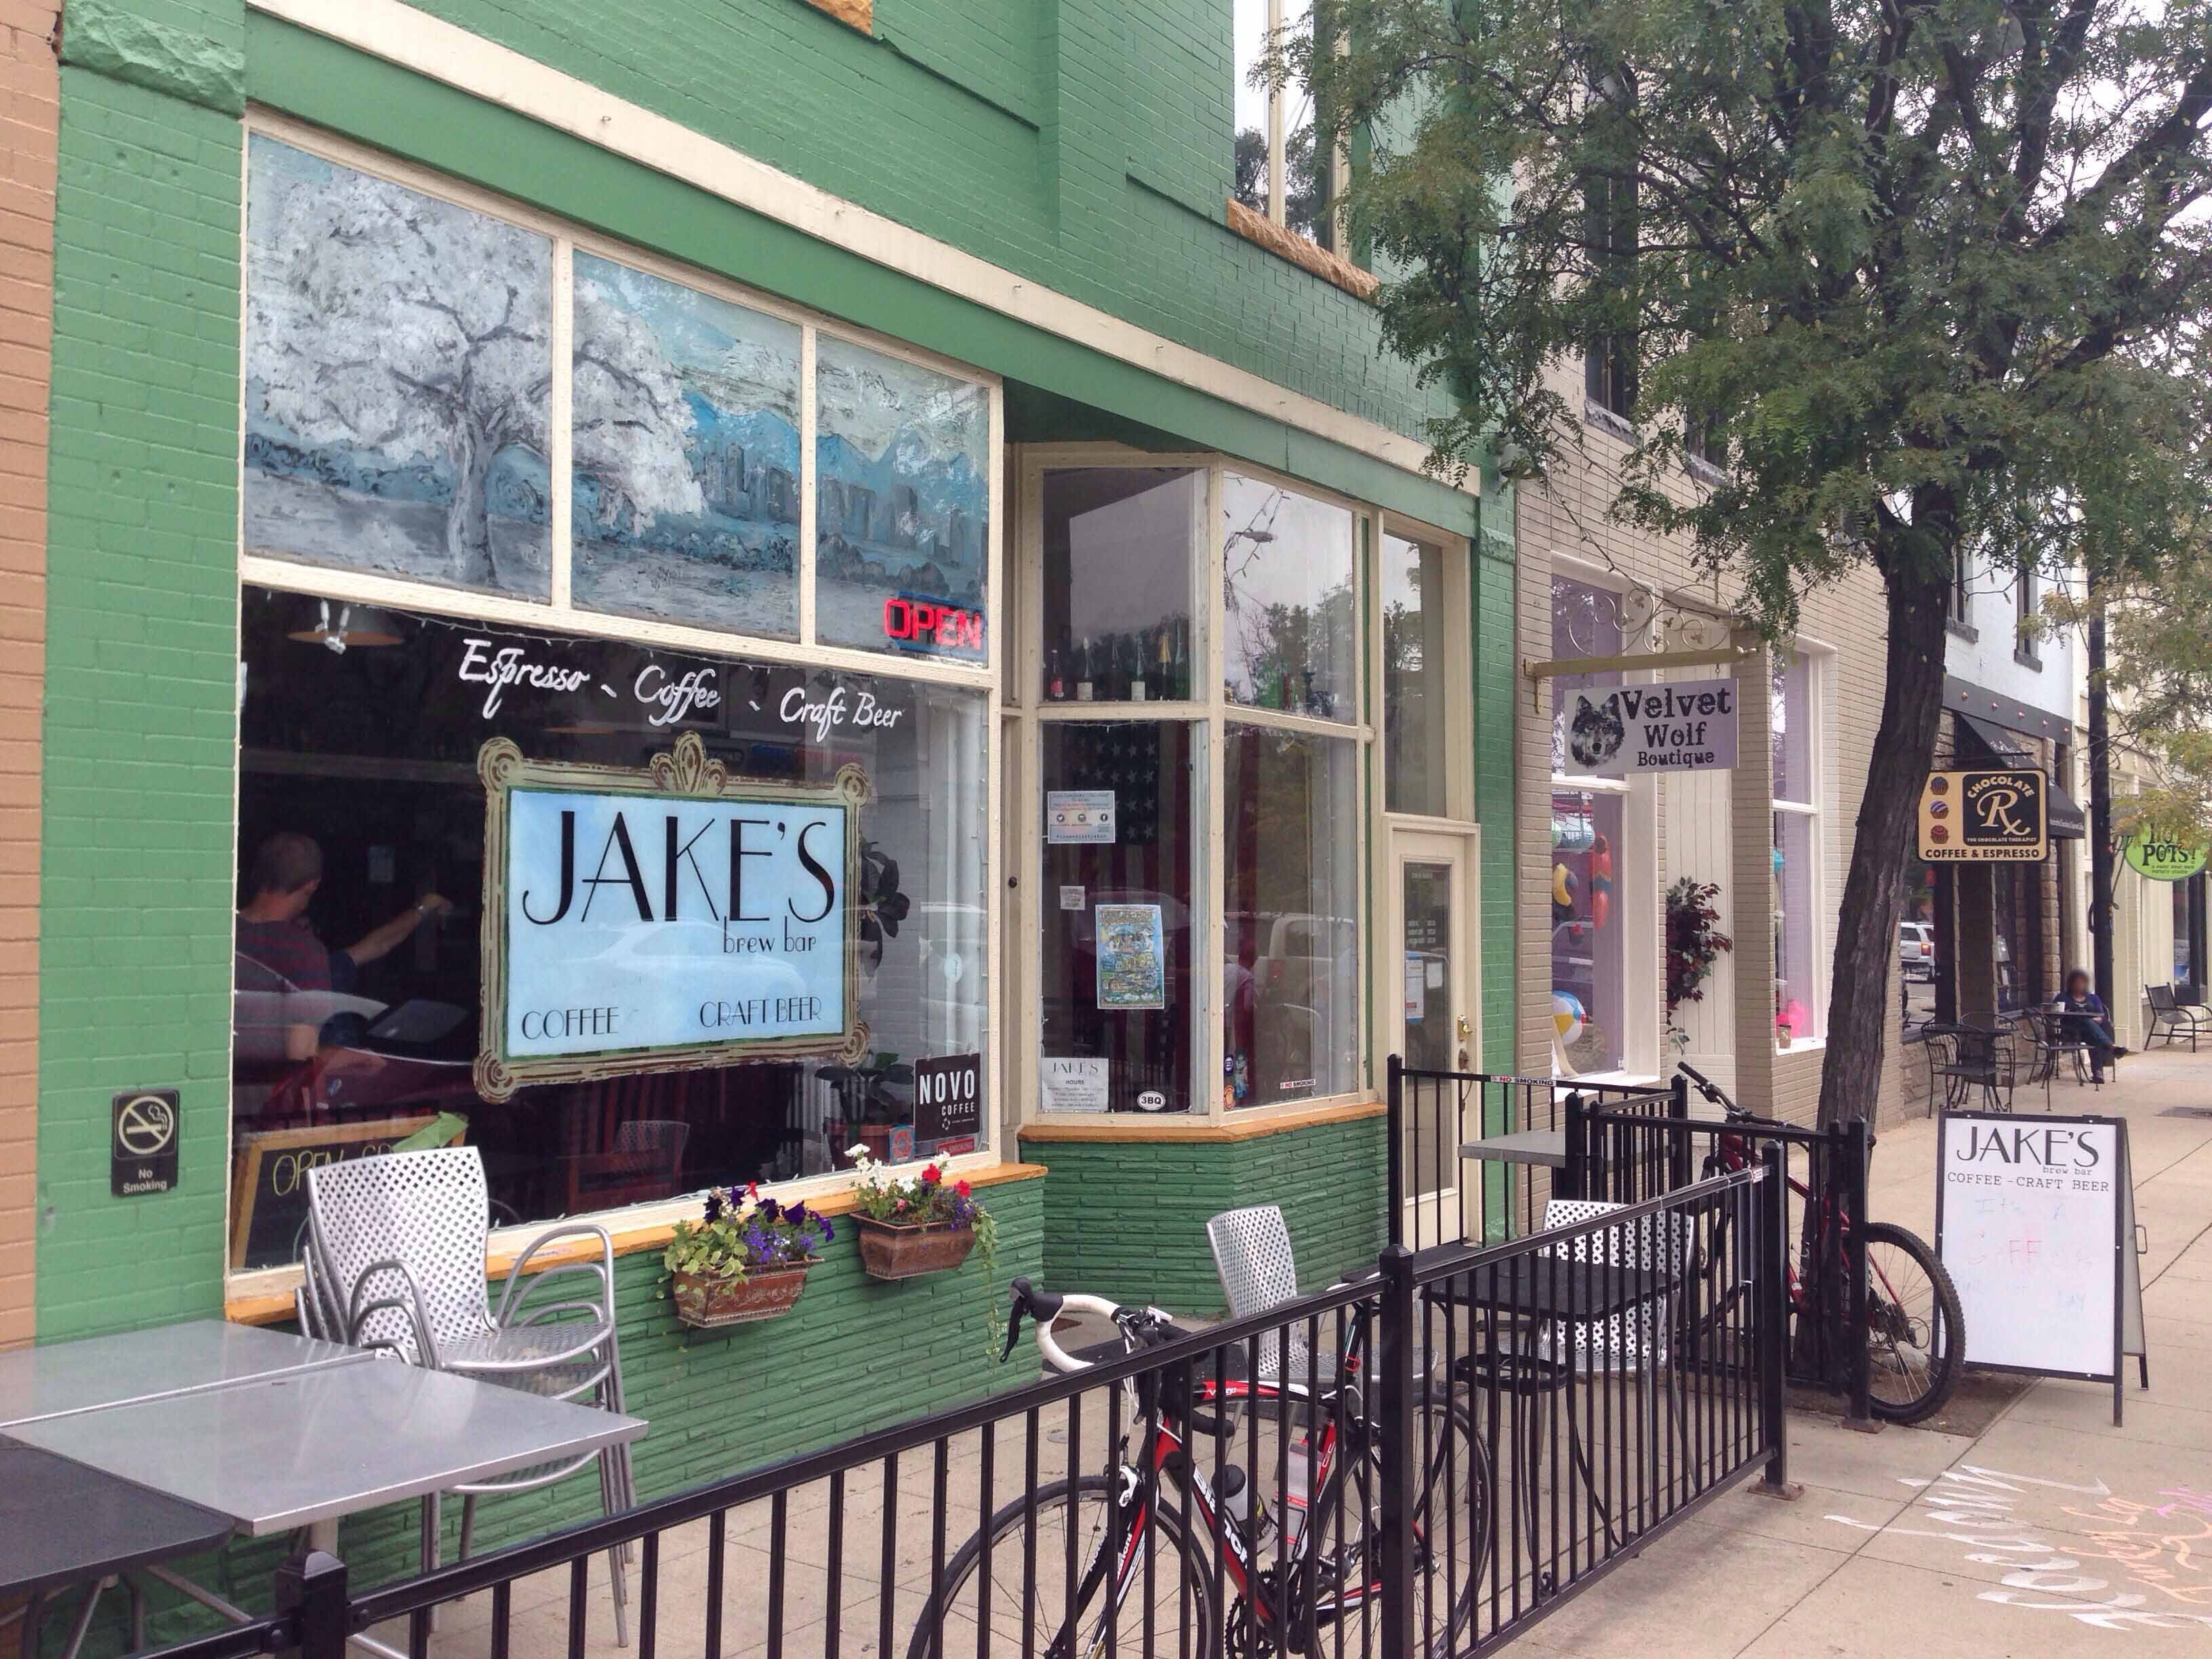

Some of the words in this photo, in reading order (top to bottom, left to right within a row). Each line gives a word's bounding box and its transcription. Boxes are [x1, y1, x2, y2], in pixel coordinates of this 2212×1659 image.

[884, 599, 982, 650] OPEN
[458, 638, 590, 720] Espresso
[634, 665, 721, 726] Coffee
[779, 686, 846, 743] Craft
[852, 693, 903, 728] Beer
[1620, 687, 1732, 720] Velvet
[1643, 722, 1707, 747] Wolf
[1637, 750, 1715, 768] Boutique
[1967, 776, 2035, 798] CHOCOLATE
[1925, 849, 1967, 859] COFFEE
[1971, 849, 1980, 858] &
[1983, 849, 2039, 858] ESPRESSO
[523, 811, 835, 925] JAKE'S
[723, 916, 775, 954] brew
[784, 916, 817, 951] bar
[522, 1007, 619, 1040] COFFEE
[700, 999, 771, 1027] CRAFT
[776, 997, 821, 1023] BEER
[920, 1069, 975, 1105] NOVO
[941, 1102, 975, 1116] COFFEE
[1141, 1096, 1162, 1105] 3BQ
[1957, 1126, 2099, 1167] JAKE'S
[138, 1169, 153, 1179] No
[1947, 1172, 2001, 1185] COFFEE
[2016, 1176, 2063, 1189] CRAFT
[2072, 1180, 2109, 1191] BEER
[2043, 1166, 2068, 1175] brew
[2074, 1167, 2092, 1176] bar
[123, 1181, 167, 1194] Smoking
